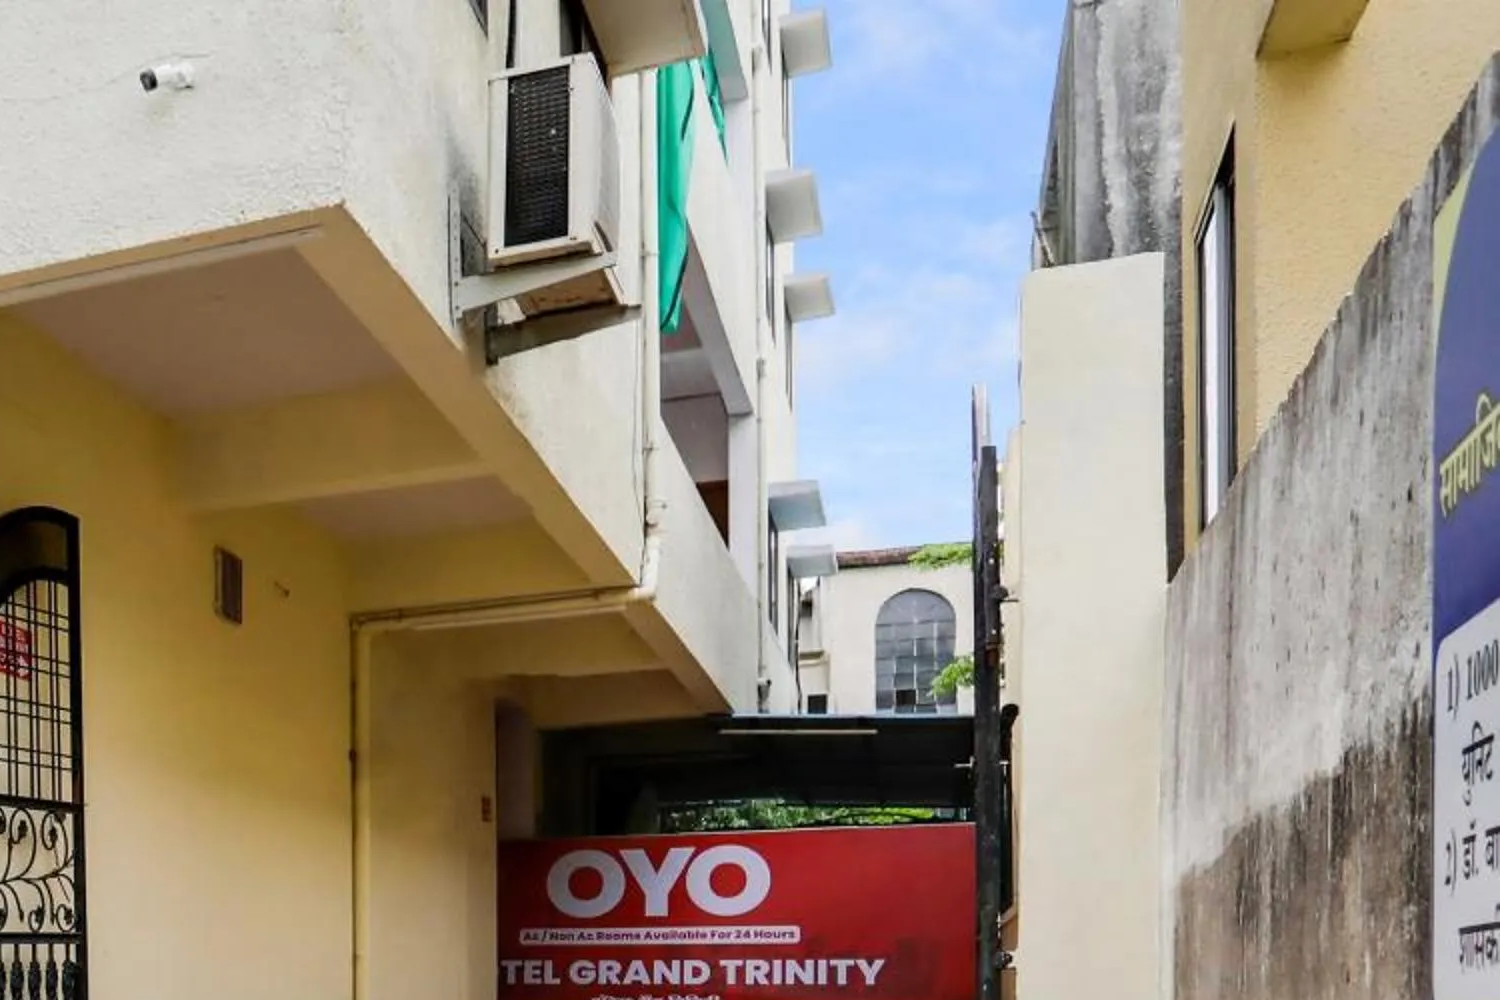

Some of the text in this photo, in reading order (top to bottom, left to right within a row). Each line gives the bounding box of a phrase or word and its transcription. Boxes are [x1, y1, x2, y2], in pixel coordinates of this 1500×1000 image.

[1467, 638, 1499, 700] 1000
[546, 844, 771, 918] OYO
[549, 930, 575, 941] Non
[596, 931, 640, 941] Rooms
[643, 929, 708, 941] Available
[710, 929, 732, 940] For
[734, 929, 752, 939] 24
[754, 928, 796, 939] Hours
[500, 958, 886, 986] TEL GRAND TRINITY
